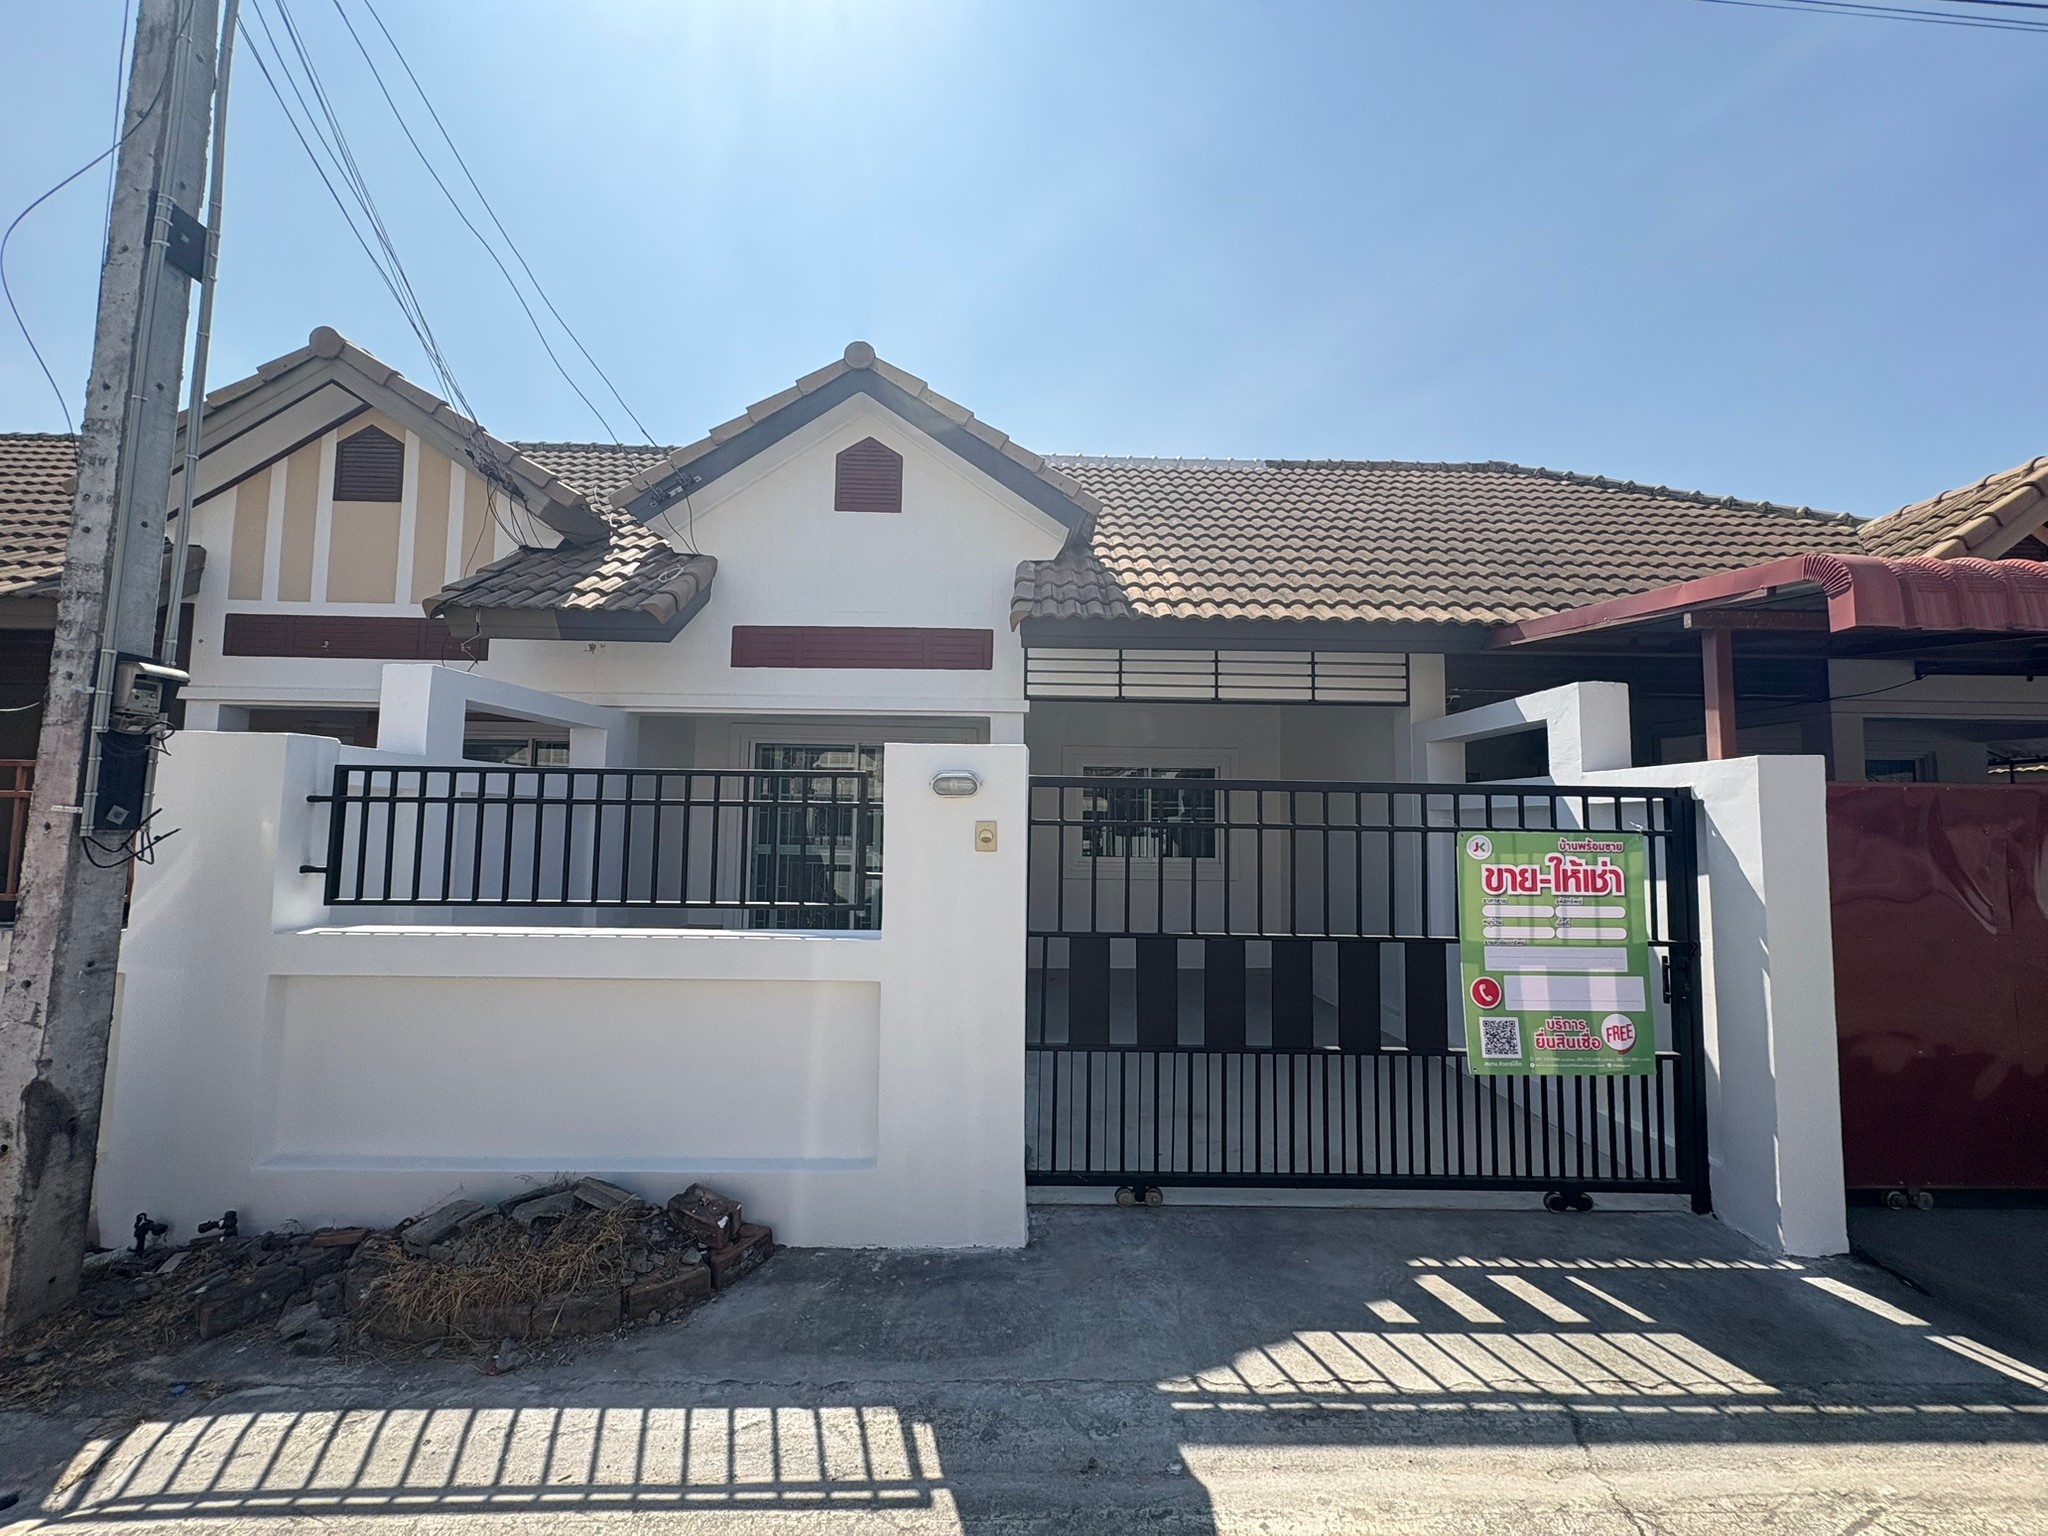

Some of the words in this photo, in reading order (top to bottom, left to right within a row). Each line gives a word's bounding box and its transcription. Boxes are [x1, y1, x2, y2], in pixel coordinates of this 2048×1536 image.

[1559, 838, 1623, 852] บ้านพร้อมขาย
[1484, 855, 1623, 893] ขาย-ให้เช่า
[1546, 1017, 1586, 1030] บริการ
[1535, 1029, 1601, 1049] ยื่นสินเชื่อ
[1606, 1024, 1633, 1043] FREE
